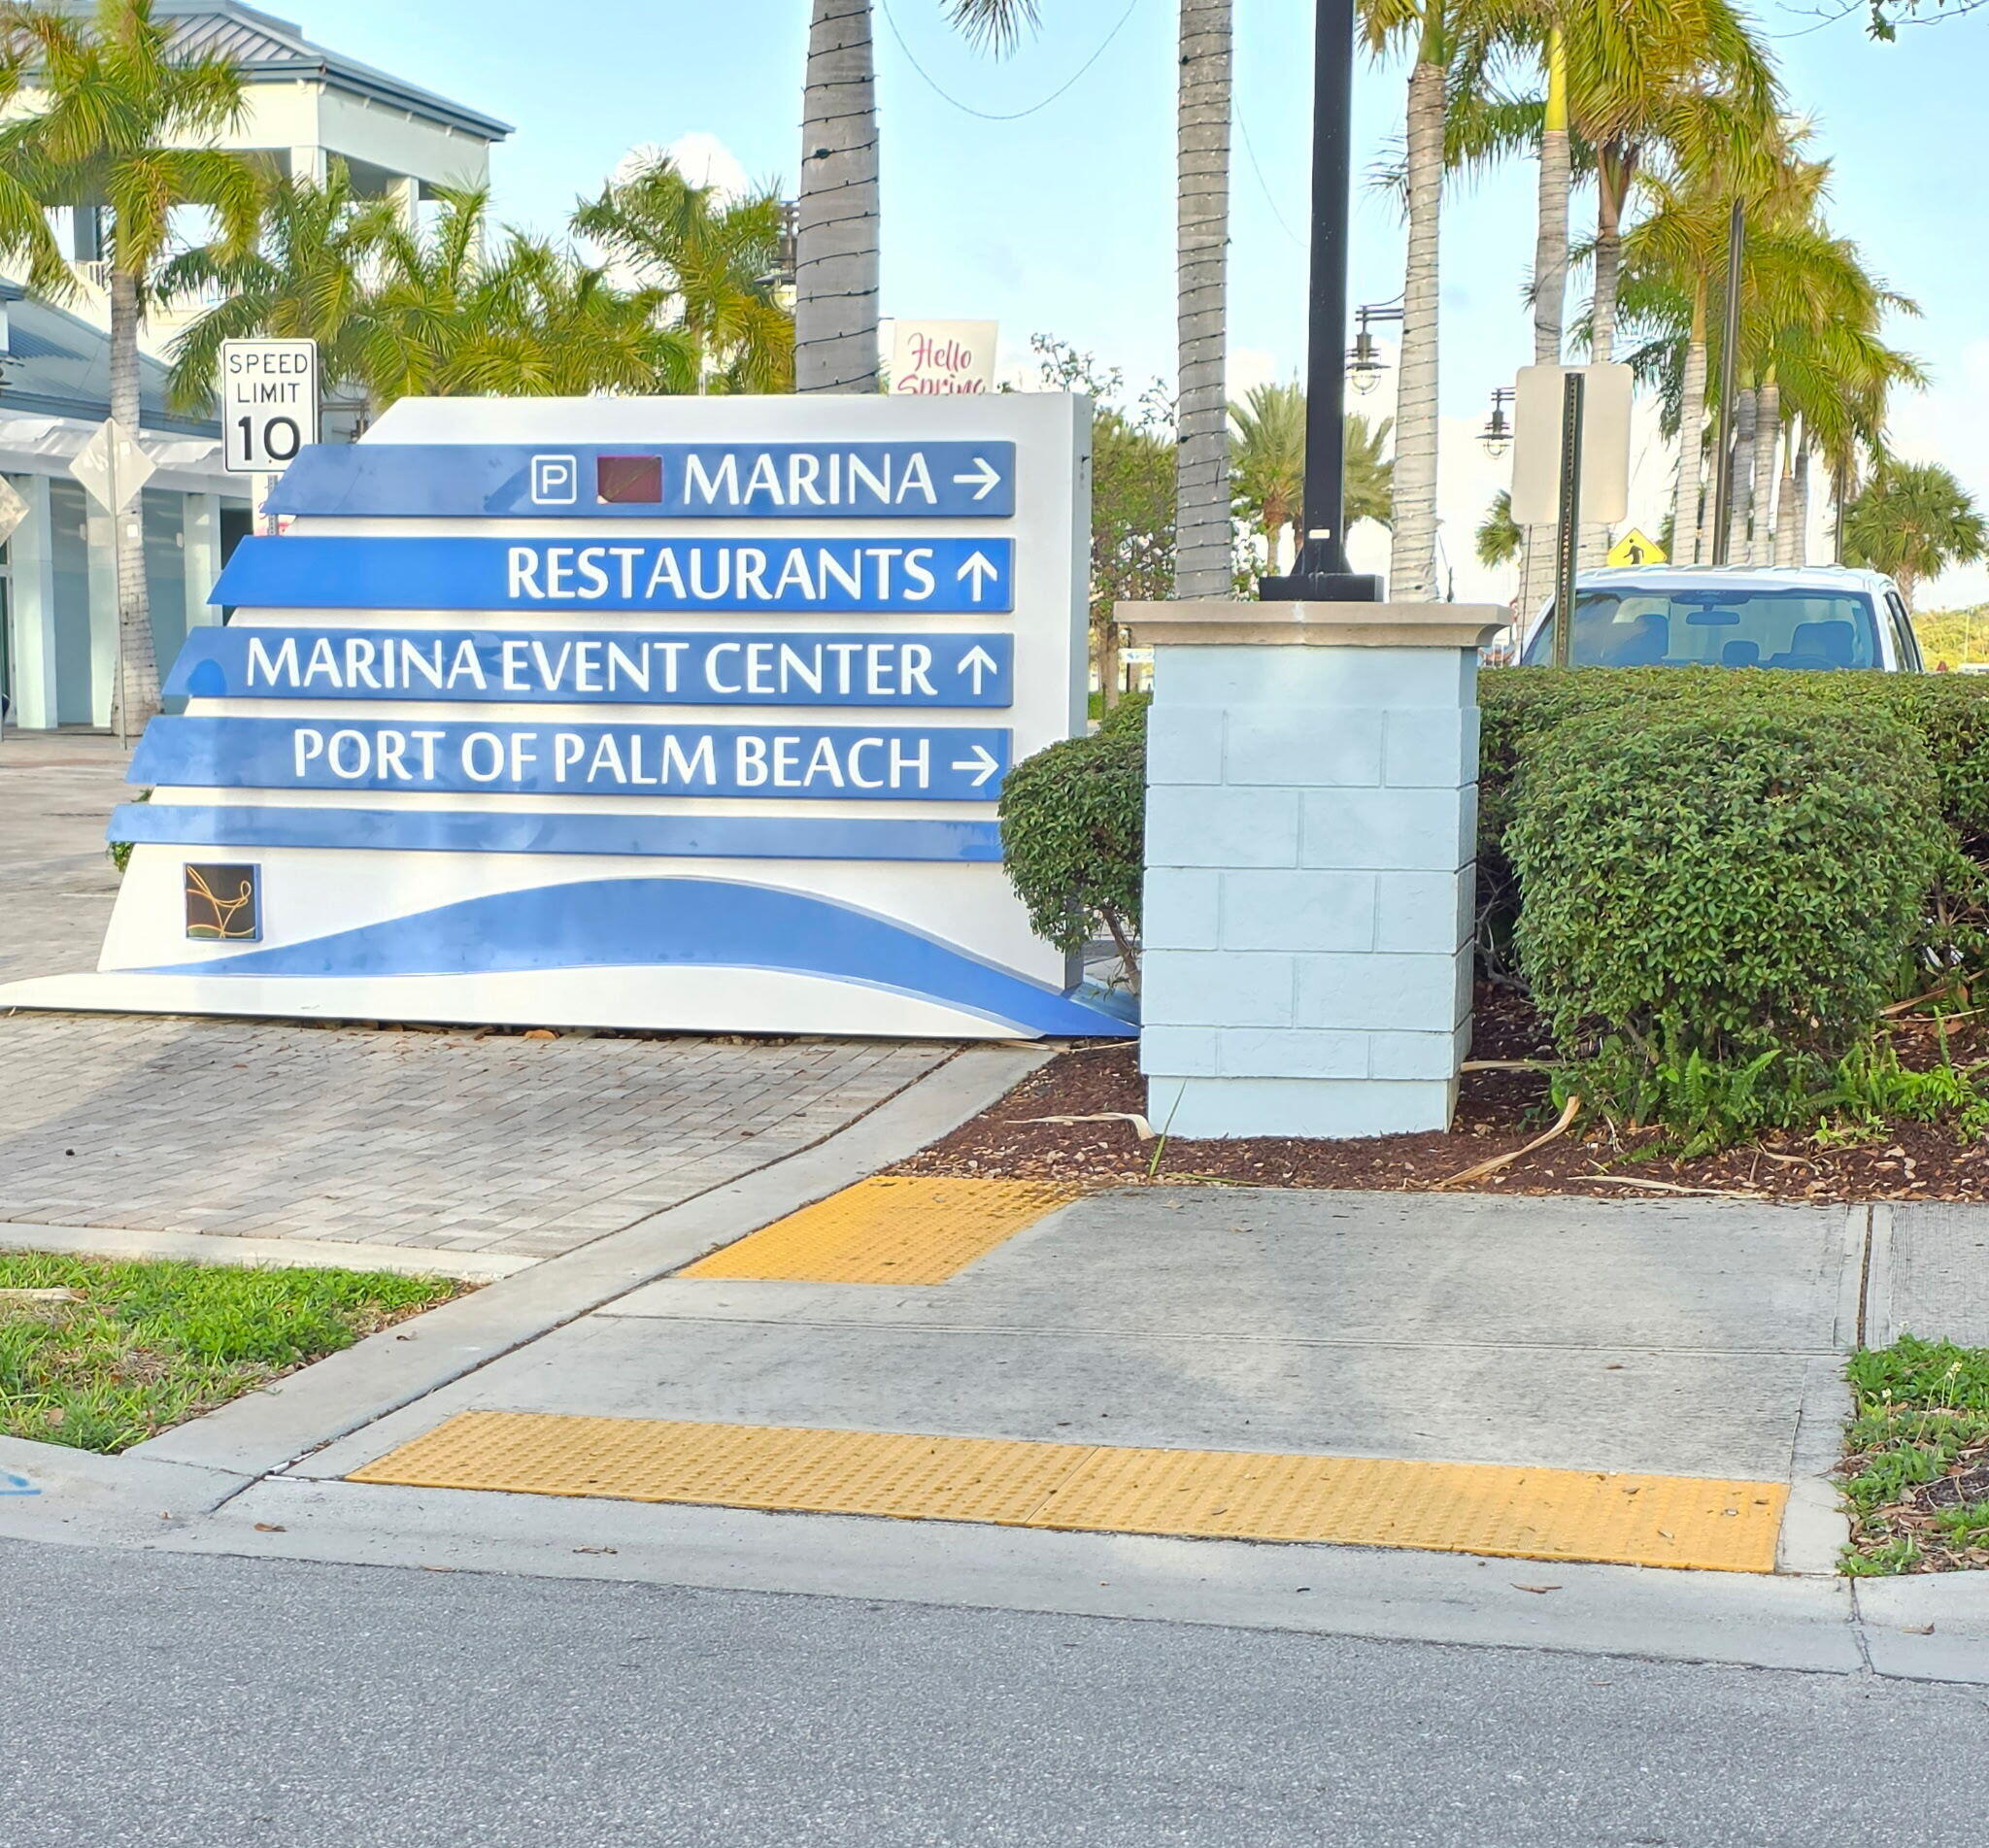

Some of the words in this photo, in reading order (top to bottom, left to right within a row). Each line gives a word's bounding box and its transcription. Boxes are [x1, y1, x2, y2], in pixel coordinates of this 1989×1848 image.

[229, 353, 308, 375] SPEED
[907, 331, 972, 373] Hello
[237, 382, 301, 404] LIMIT
[237, 415, 302, 462] 10
[542, 464, 569, 495] P
[683, 453, 938, 506] MARINA
[507, 546, 936, 601] RESTAURANTS
[246, 636, 489, 690] MARINA
[501, 639, 691, 693] EVENT
[704, 641, 939, 696] CENTER
[293, 727, 447, 782] PORT
[460, 730, 539, 783] OF
[553, 731, 718, 787] PALM
[735, 734, 930, 790] BEACH
